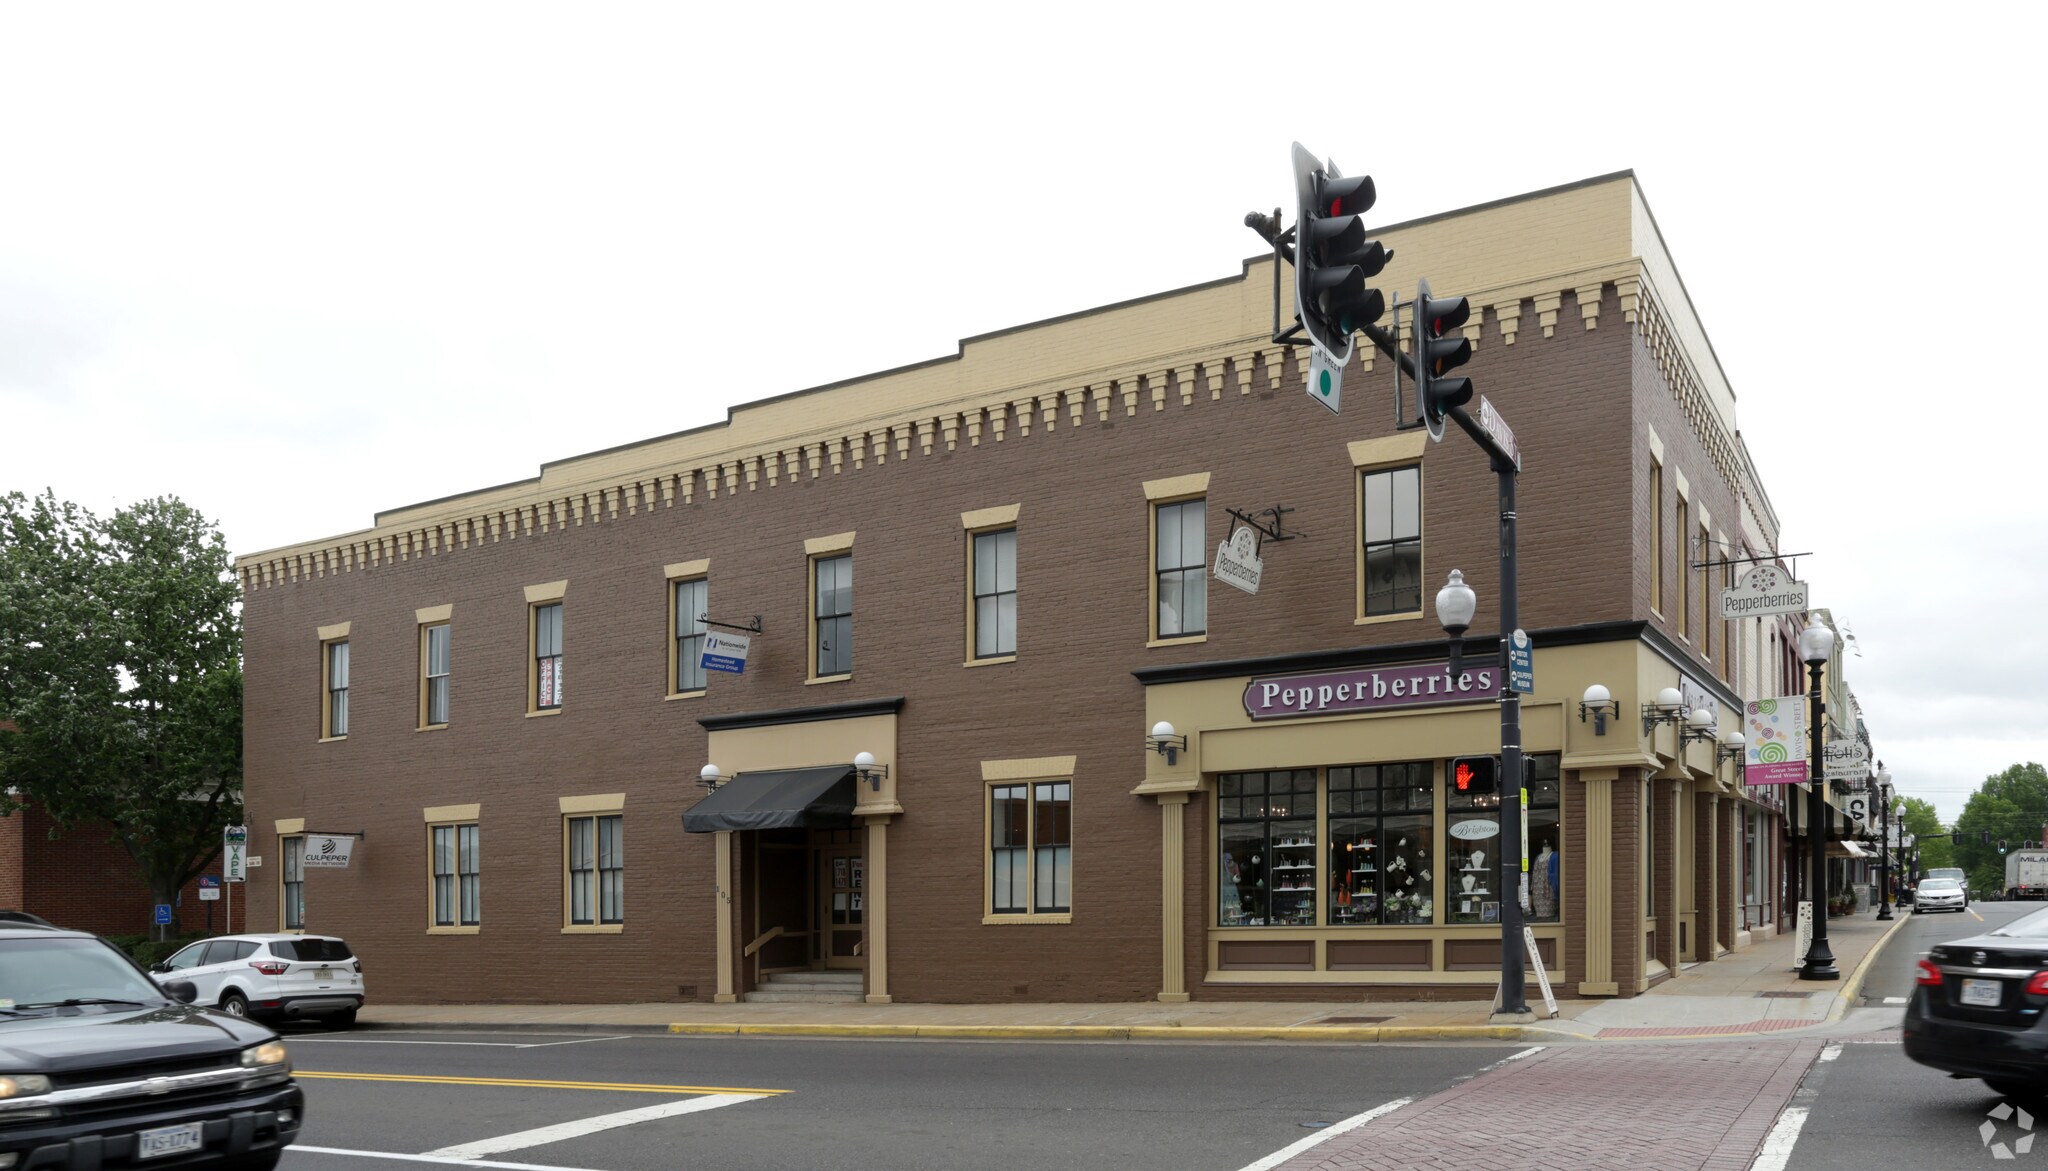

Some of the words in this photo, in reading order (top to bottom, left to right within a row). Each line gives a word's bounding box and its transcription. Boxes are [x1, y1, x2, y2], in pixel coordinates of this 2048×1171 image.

[1219, 552, 1258, 585] Pepperberries
[1725, 592, 1804, 613] Pepperberries
[719, 640, 747, 650] Nationwide
[1261, 667, 1492, 711] Pepperberries
[230, 845, 240, 876] VAPE
[305, 854, 348, 862] CULPEPER
